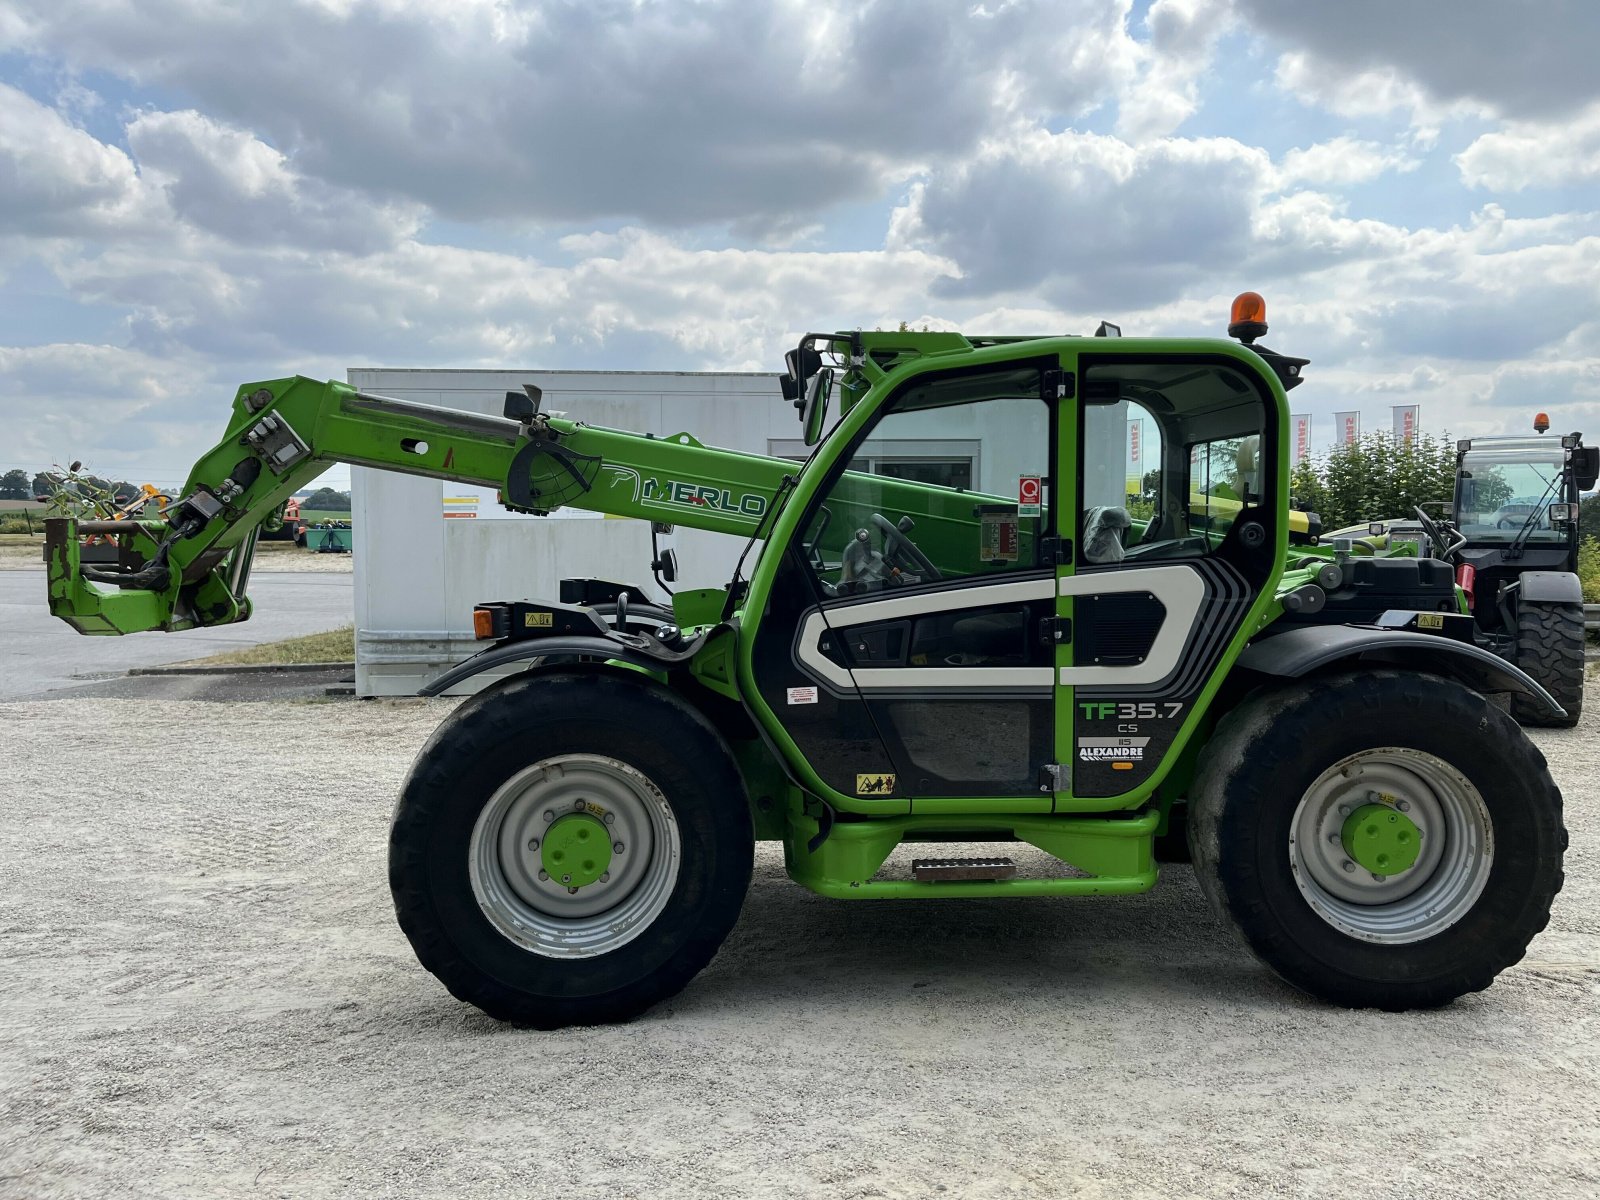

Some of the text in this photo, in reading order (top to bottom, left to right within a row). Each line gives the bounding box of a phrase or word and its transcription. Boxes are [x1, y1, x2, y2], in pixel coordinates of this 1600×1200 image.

[642, 477, 766, 517] MERLO
[1079, 703, 1183, 719] TF35.7
[1117, 724, 1138, 733] CS
[1079, 747, 1143, 756] ALEXANDRE
